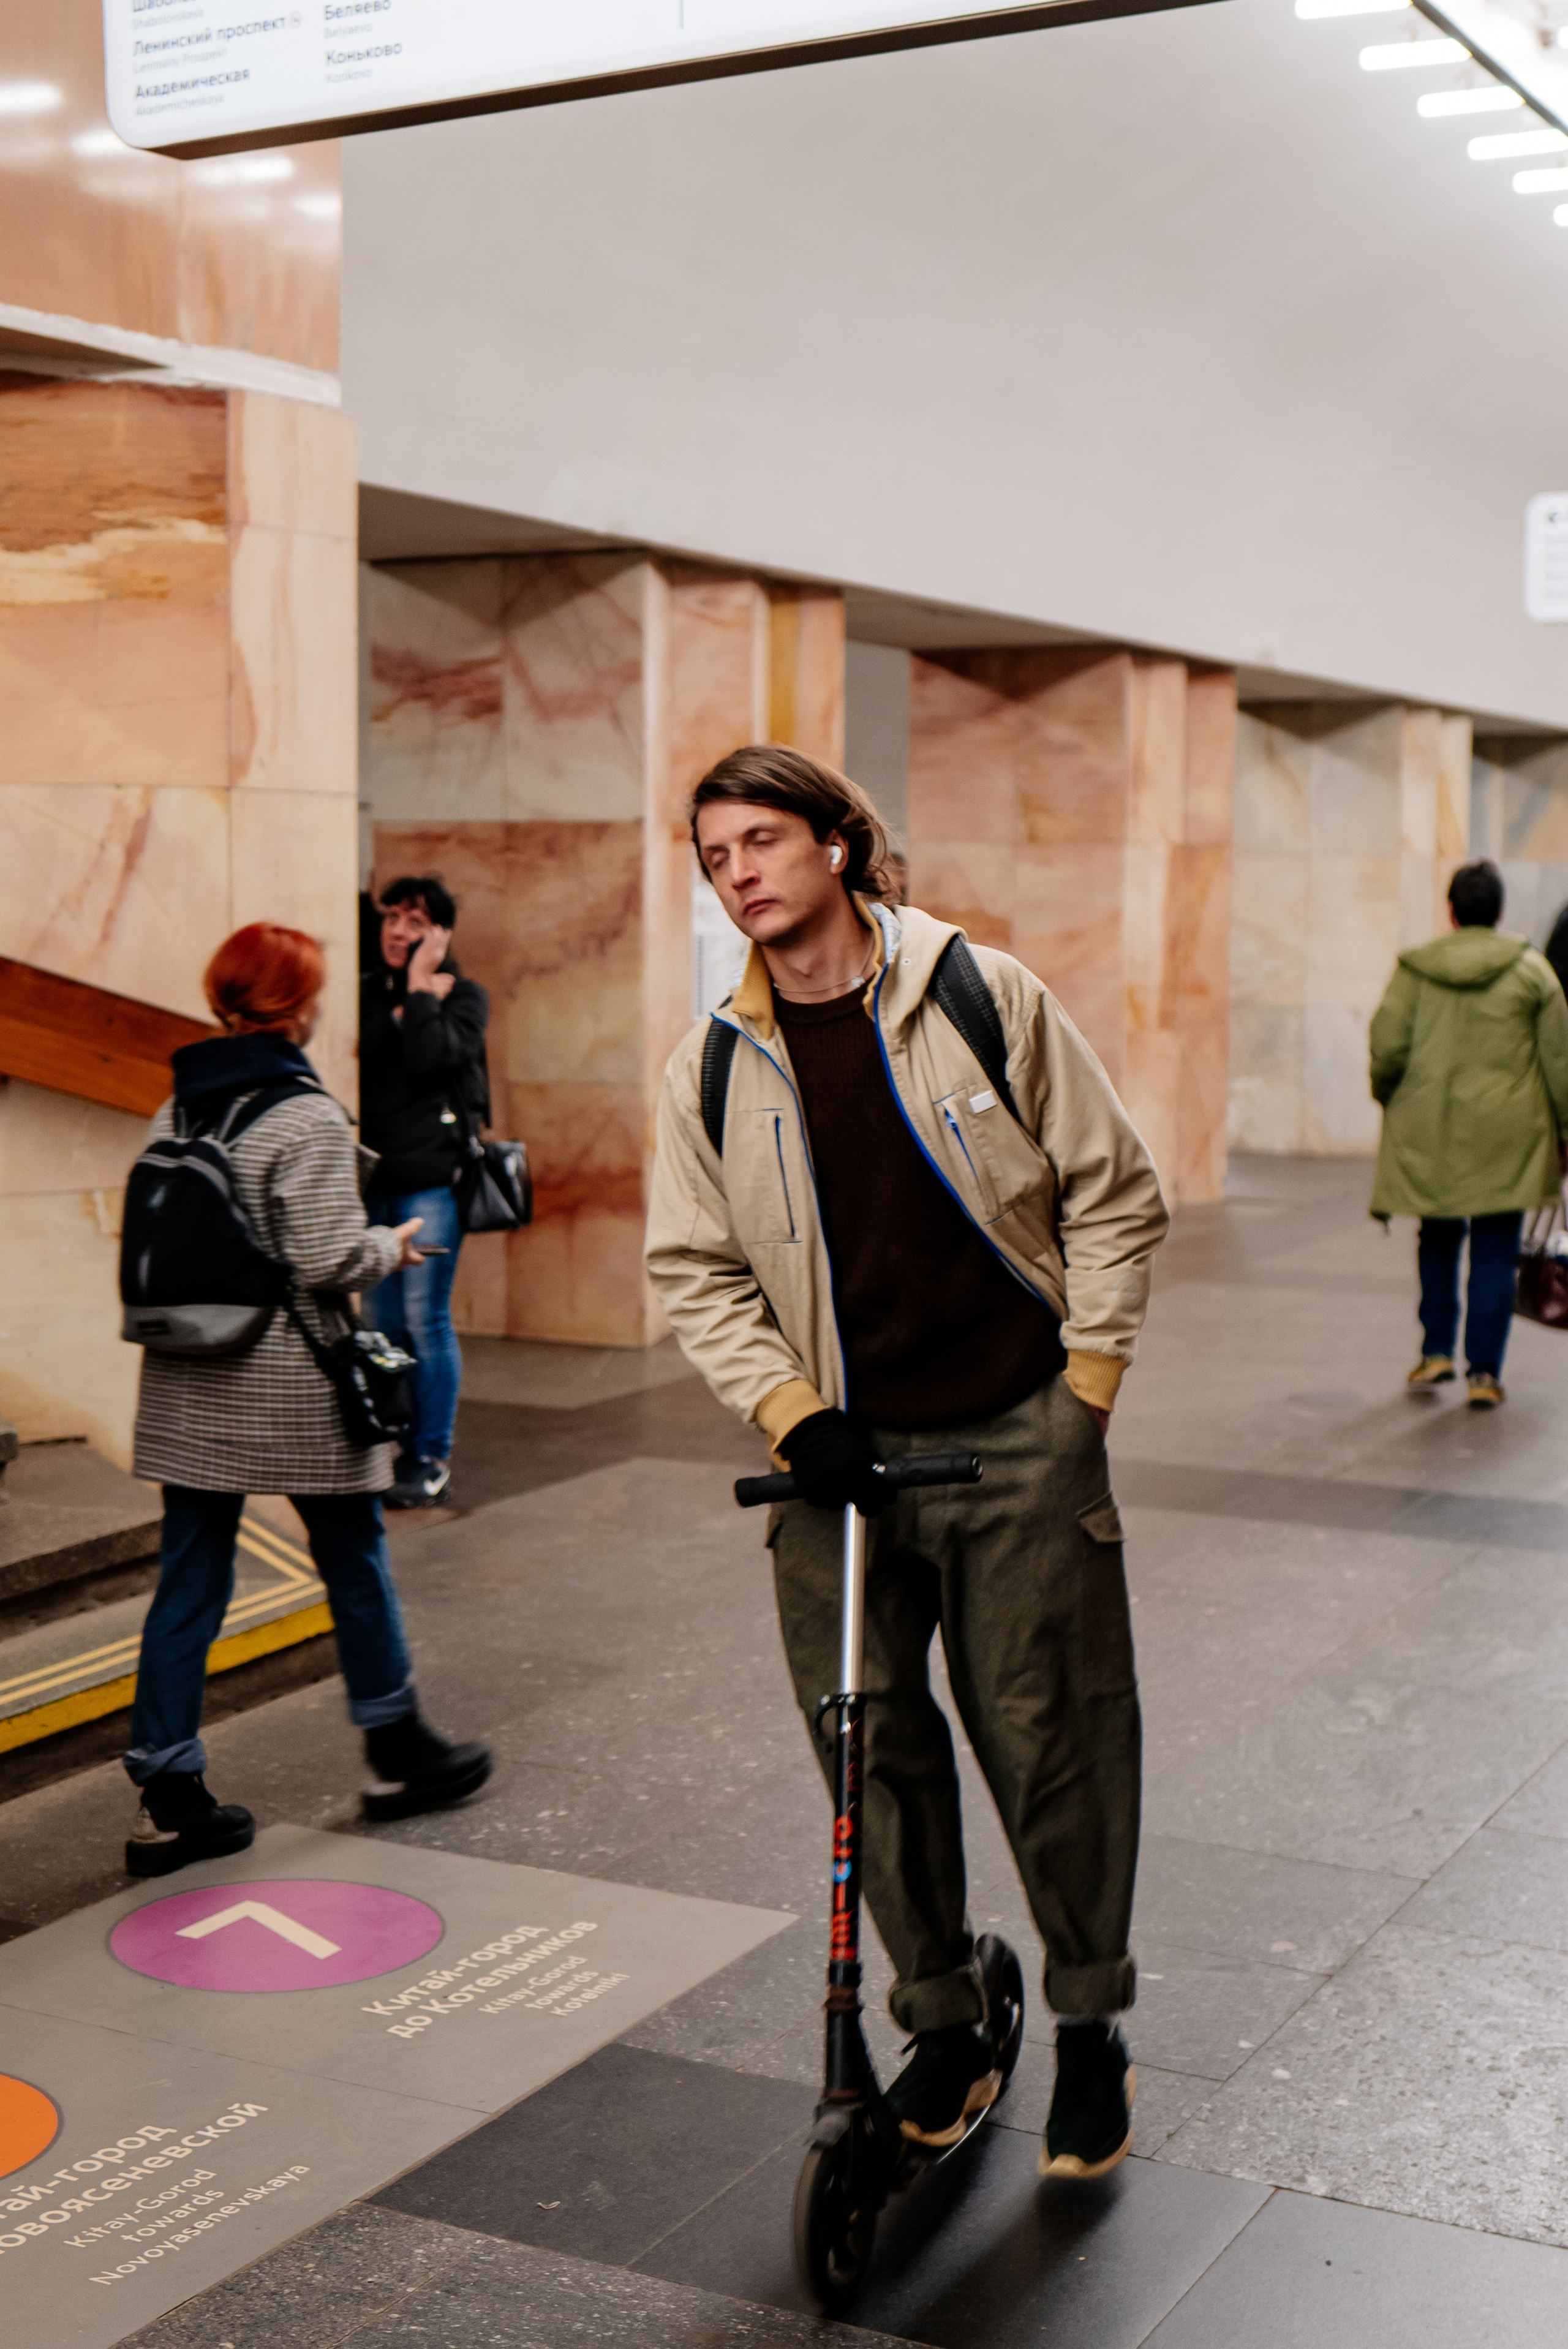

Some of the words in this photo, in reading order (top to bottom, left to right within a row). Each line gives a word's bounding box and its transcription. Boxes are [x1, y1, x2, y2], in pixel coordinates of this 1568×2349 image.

[133, 27, 213, 56] Ленинский
[217, 17, 286, 42] проспект
[324, 0, 392, 20] Беляево
[325, 43, 403, 66] Коньково
[135, 67, 251, 99] Академическая
[361, 1925, 550, 2016] Китай-город
[386, 2015, 433, 2039] до
[419, 1921, 598, 2015] Котельников
[478, 1955, 588, 2014] Kitay-Gorod
[524, 1970, 600, 2009] towards
[549, 1972, 631, 2016] Kotelniki
[0, 2125, 178, 2219] ай-город
[0, 2103, 269, 2255] овоясеневской
[63, 2168, 217, 2248] Kitay-Gorod
[88, 2163, 311, 2285] Novoyasenevskaya
[120, 2189, 225, 2243] towards
